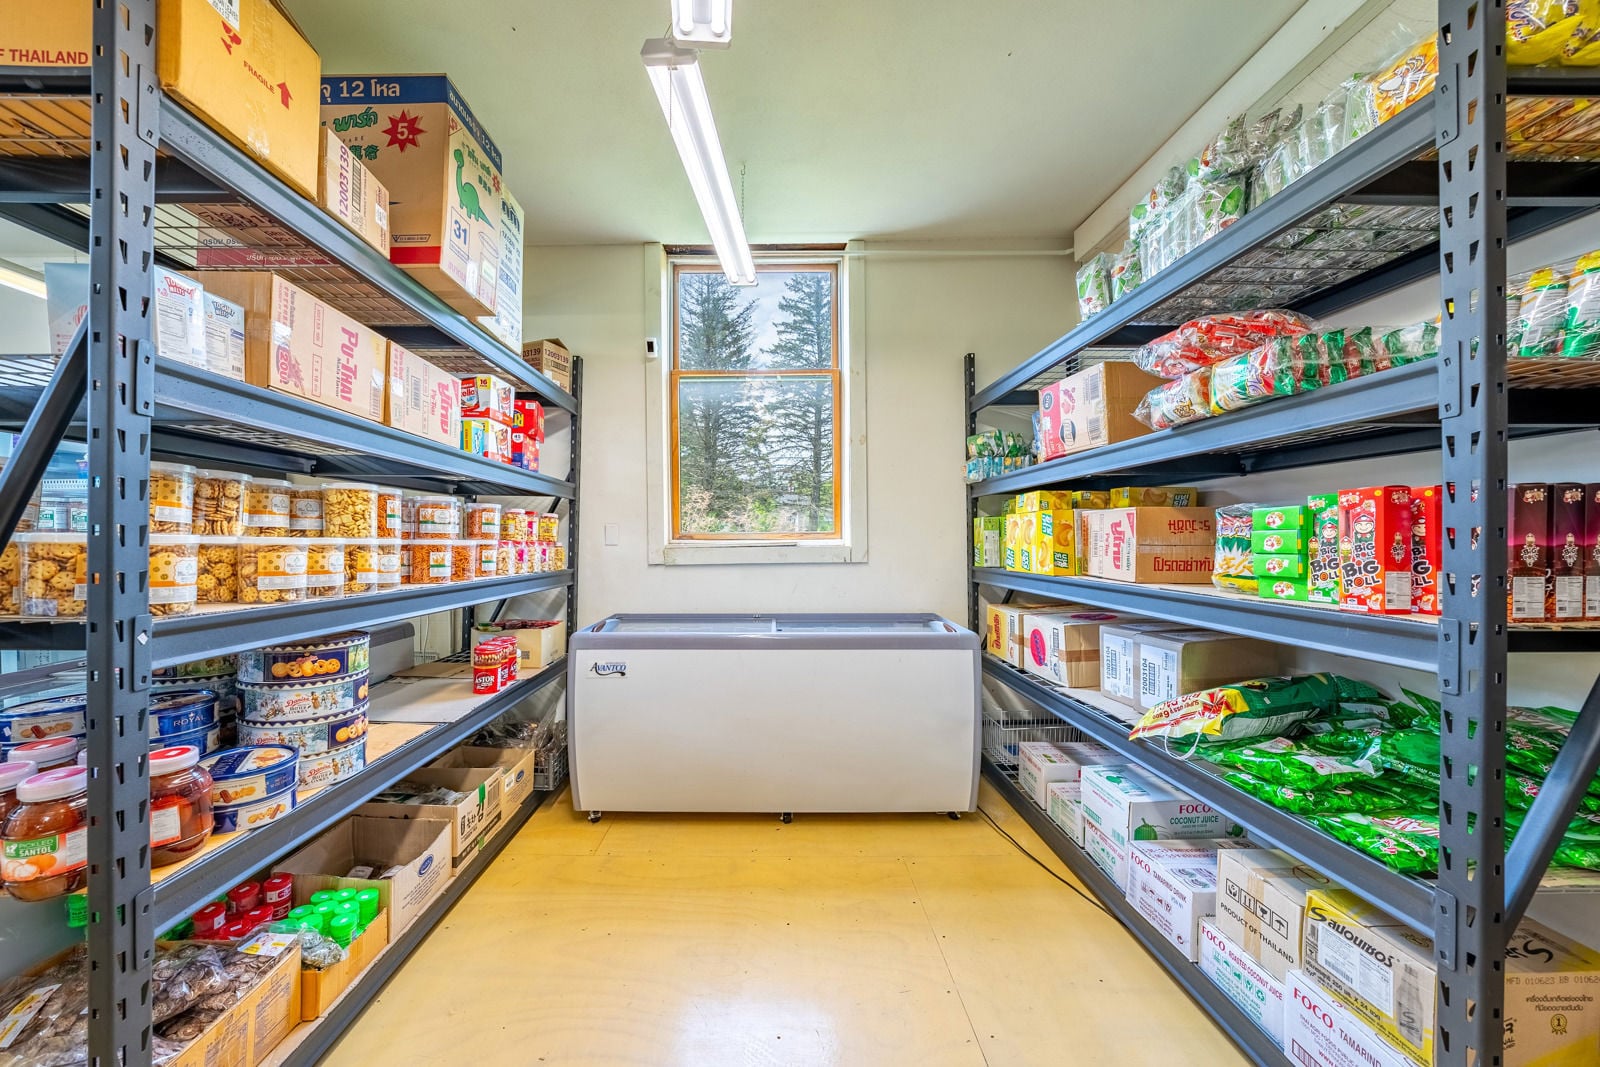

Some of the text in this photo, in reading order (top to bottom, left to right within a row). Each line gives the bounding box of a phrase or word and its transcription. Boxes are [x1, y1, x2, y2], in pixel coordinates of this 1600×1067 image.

[9, 49, 88, 65] THAILAND
[244, 60, 275, 94] FRAGILE
[340, 81, 364, 97] 12
[370, 79, 400, 97] โหล
[340, 145, 350, 218] 12003139
[454, 220, 467, 246] 31
[1153, 556, 1214, 572] โปรดอย่าทับ
[1312, 572, 1339, 583] ROLL
[1345, 576, 1381, 588] ROLL
[173, 714, 206, 727] ROYAL
[1179, 803, 1212, 815] FOCO
[1170, 815, 1219, 825] COCONUT JUICE
[19, 839, 54, 849] PICKLED
[19, 846, 53, 857] SANTOL
[1130, 852, 1151, 873] FOCO
[1220, 902, 1294, 964] PRODUCT OF THAILAND
[1201, 925, 1226, 952] FOCO
[1247, 966, 1268, 989] COCONUT
[1269, 984, 1283, 1000] JUICE
[1505, 976, 1521, 985] MFD
[1525, 976, 1556, 985] 010623
[1293, 987, 1333, 1029] FOCO
[1339, 1027, 1382, 1067] TAMARIND
